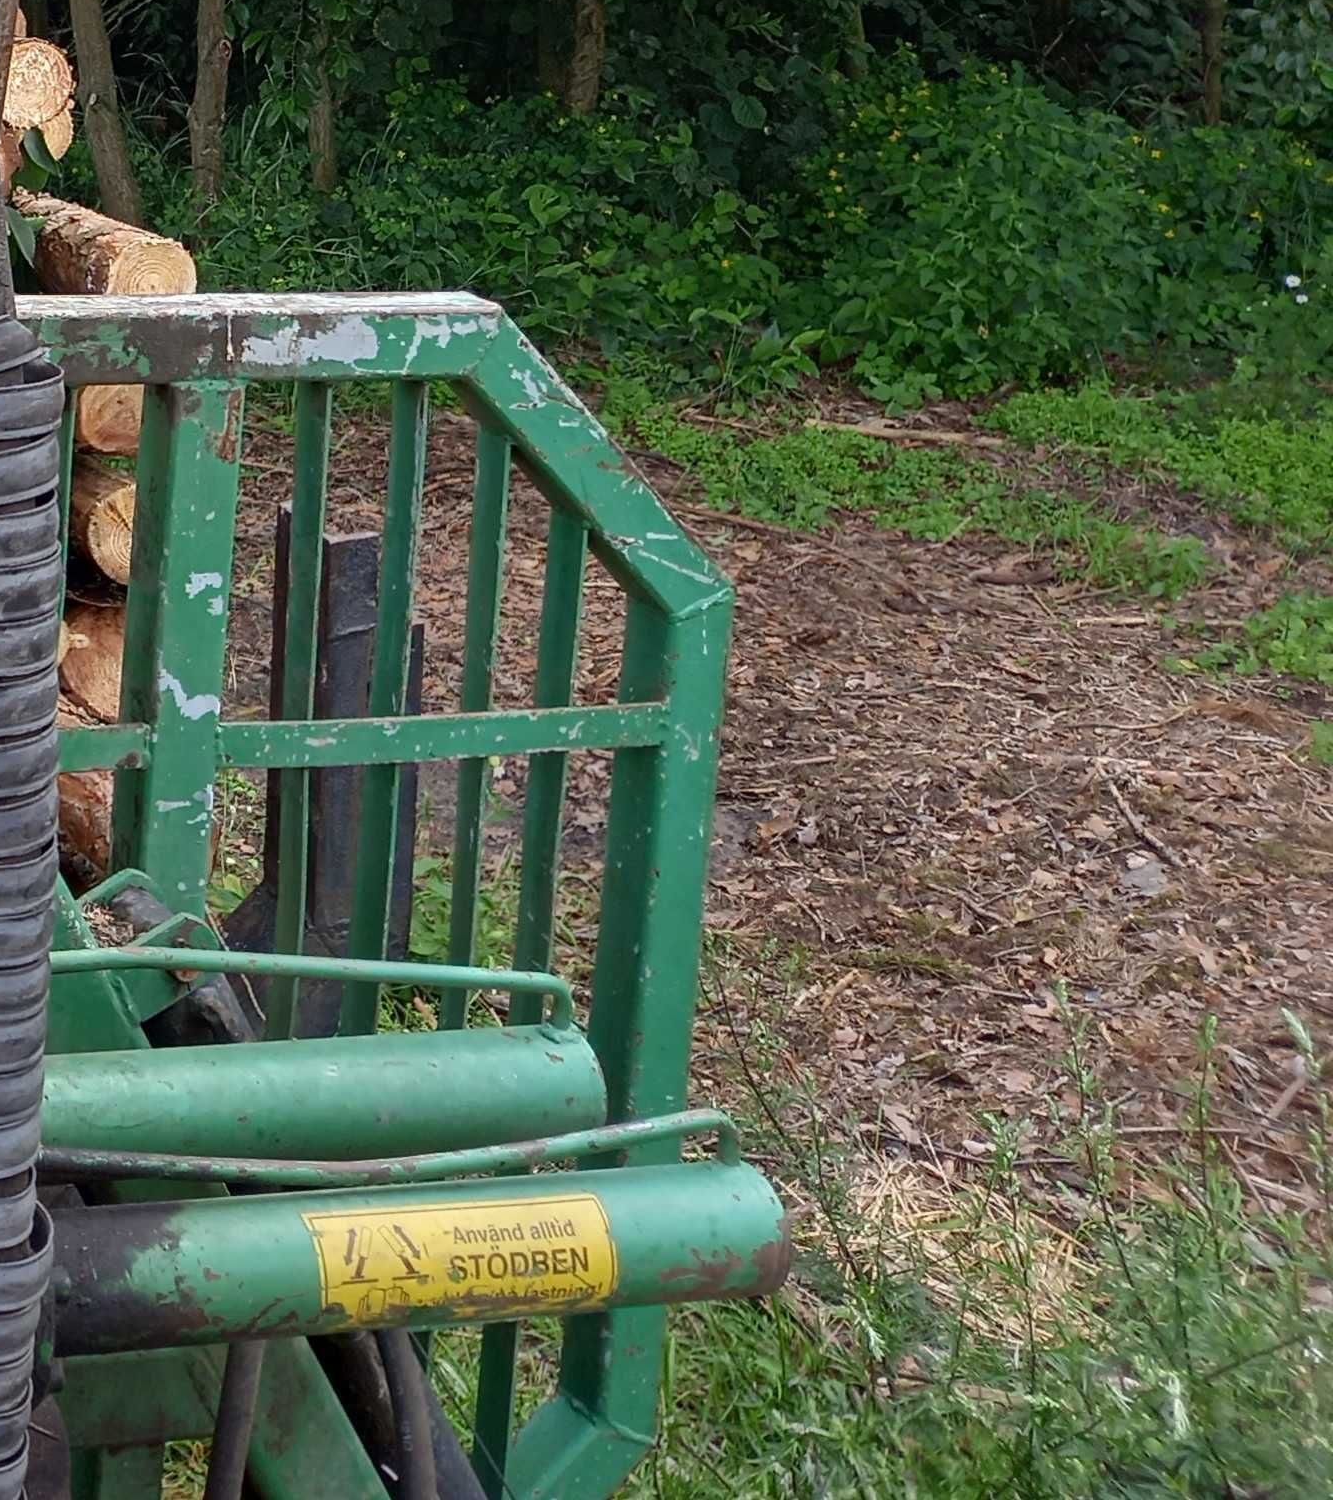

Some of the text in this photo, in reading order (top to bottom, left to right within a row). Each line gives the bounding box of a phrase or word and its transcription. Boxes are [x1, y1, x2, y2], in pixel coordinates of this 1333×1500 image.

[453, 1217, 576, 1244] Använd alltid
[447, 1246, 589, 1283] STÖDBEN
